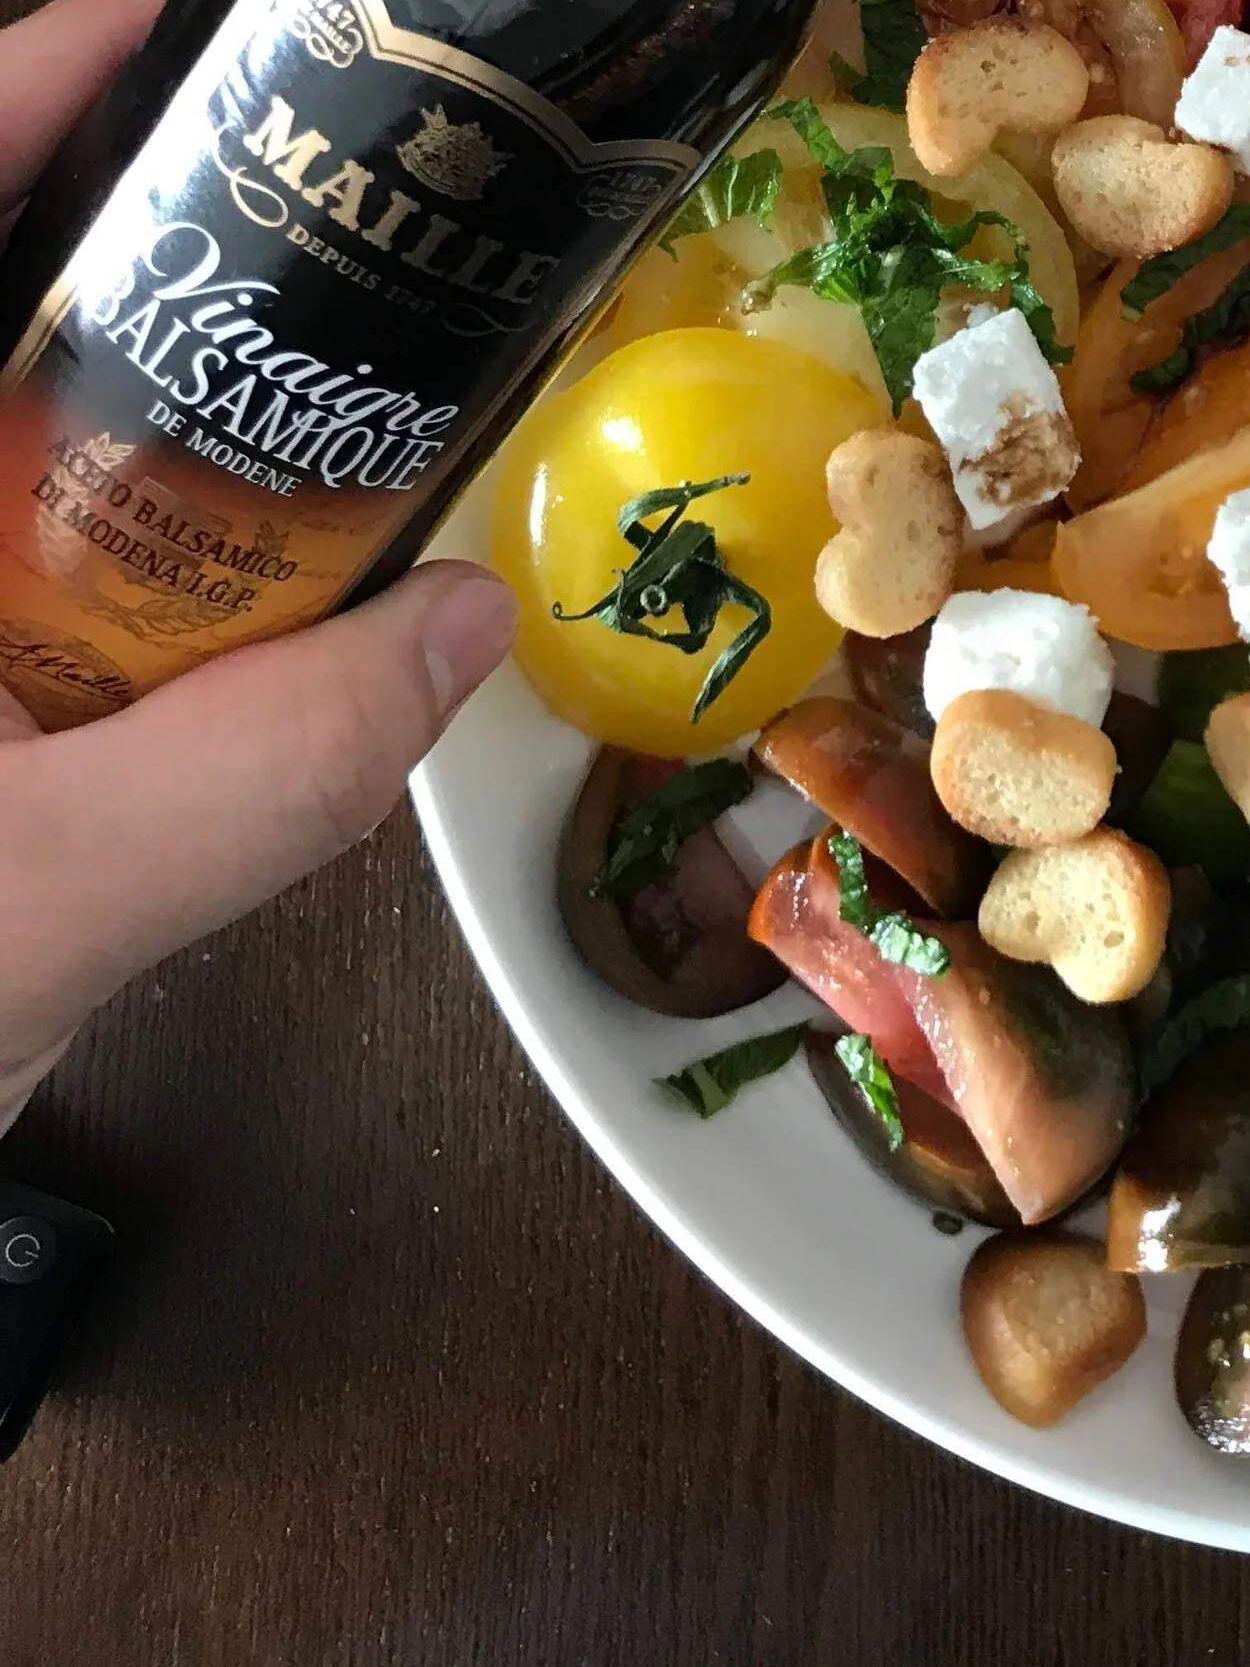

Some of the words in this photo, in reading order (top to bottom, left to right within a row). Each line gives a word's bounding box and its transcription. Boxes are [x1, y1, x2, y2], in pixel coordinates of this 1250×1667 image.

[243, 94, 561, 304] MAILLE
[286, 223, 382, 291] DEPUIS
[84, 258, 445, 490] BALSAMIQUE
[145, 221, 459, 436] Vinaigre
[47, 436, 132, 508] ACETO
[132, 497, 298, 582] BALSAMICO
[146, 399, 187, 437] DE
[186, 424, 302, 497] MODENE
[31, 471, 66, 510] DI
[62, 501, 183, 587] MODENA
[184, 570, 257, 613] I.G.P.
